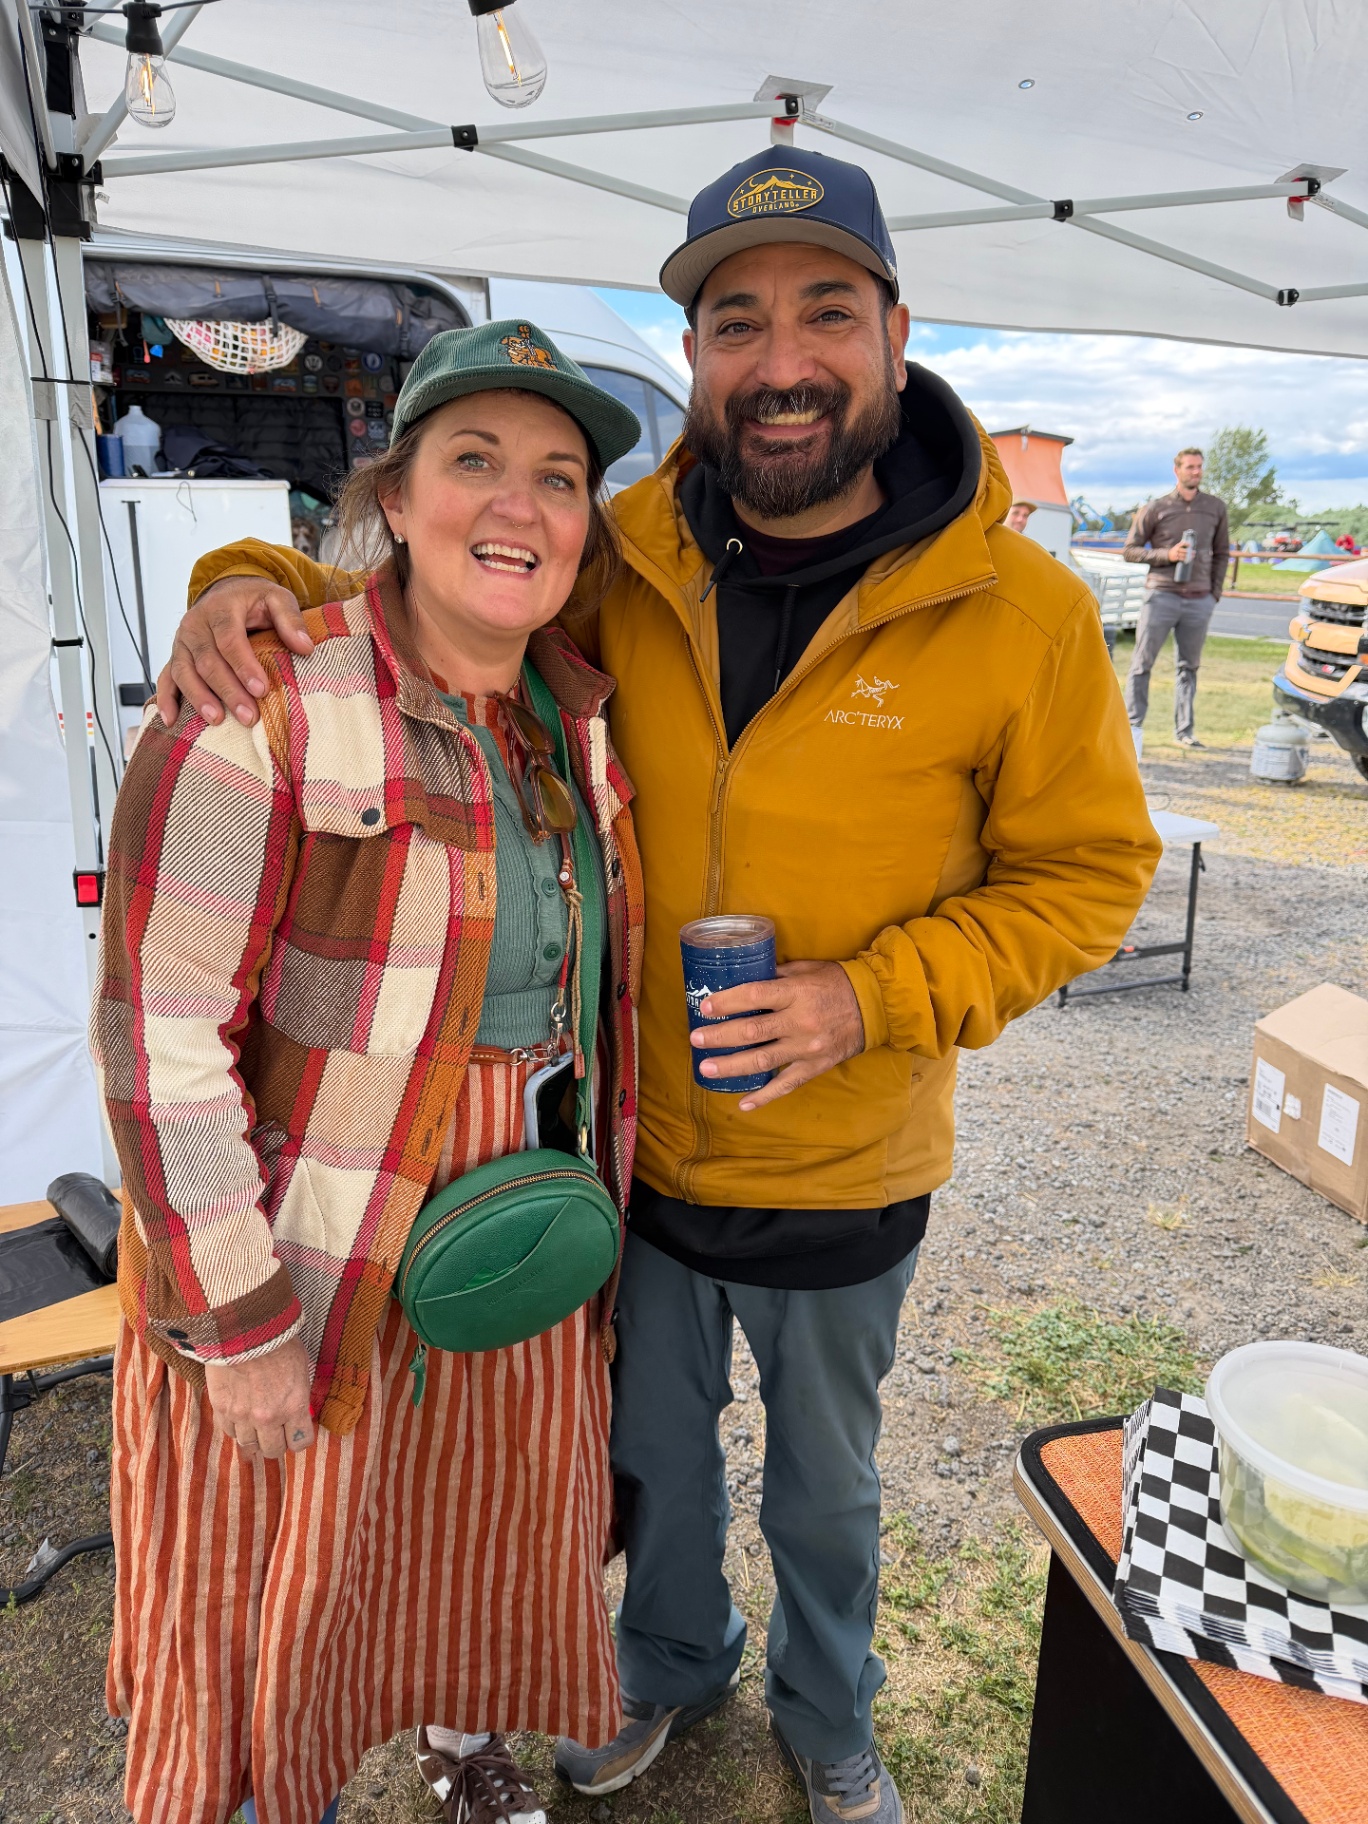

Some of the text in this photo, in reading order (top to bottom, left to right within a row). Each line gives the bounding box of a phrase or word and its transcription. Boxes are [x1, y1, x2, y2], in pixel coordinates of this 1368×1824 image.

[732, 189, 818, 212] STORYTELLER
[752, 201, 796, 214] OVERLAND
[824, 709, 905, 730] ARC'TERYX
